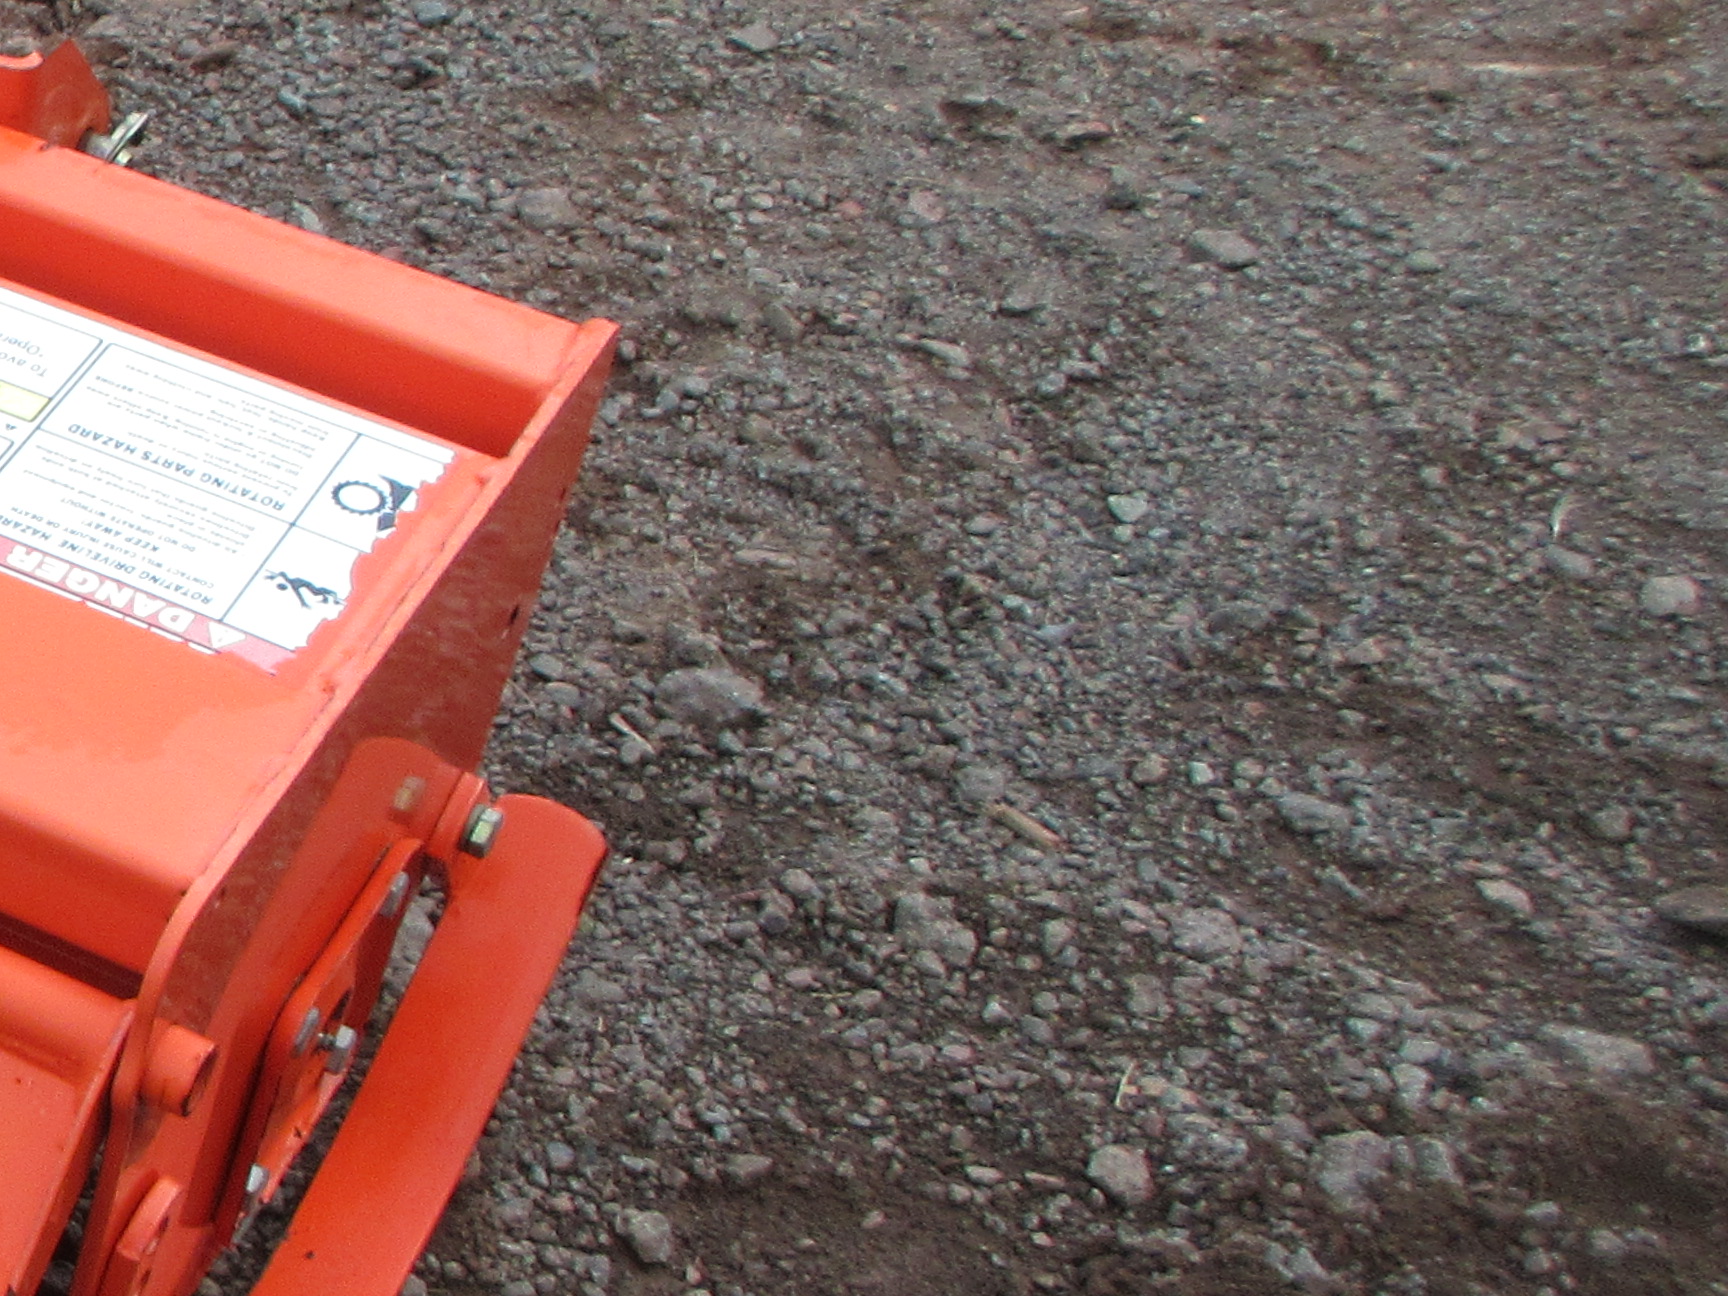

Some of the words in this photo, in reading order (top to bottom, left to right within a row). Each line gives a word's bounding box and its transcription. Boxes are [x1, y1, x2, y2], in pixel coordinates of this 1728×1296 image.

[65, 422, 138, 454] HAZARD
[137, 449, 196, 477] PARTS
[196, 472, 286, 511] ROTATING
[56, 538, 137, 574] DRIVELINE
[0, 543, 198, 632] DANGER
[136, 569, 213, 604] ROTATING
